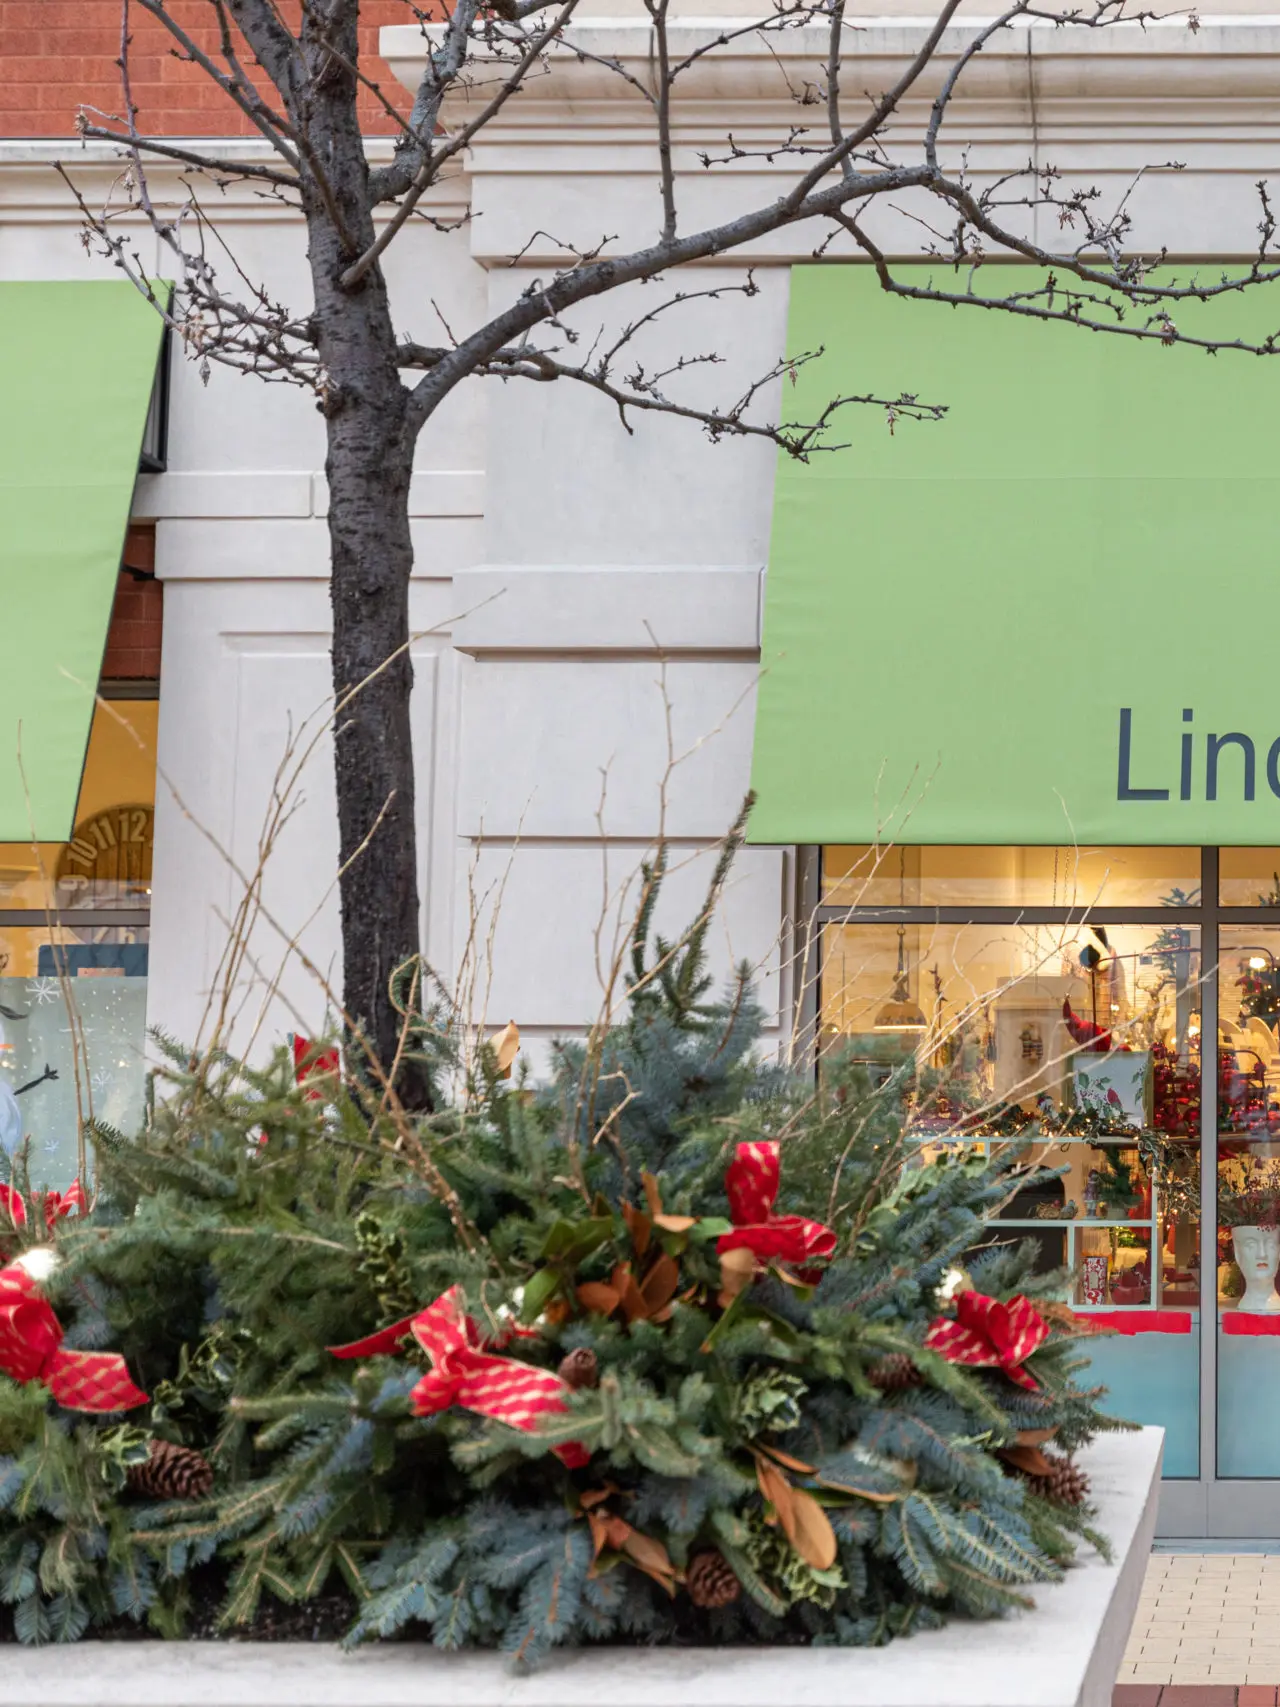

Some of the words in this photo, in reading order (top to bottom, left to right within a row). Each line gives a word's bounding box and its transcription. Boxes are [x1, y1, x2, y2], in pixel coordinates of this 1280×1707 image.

[88, 816, 118, 850] 11
[118, 810, 147, 842] 12
[66, 837, 98, 868] 10
